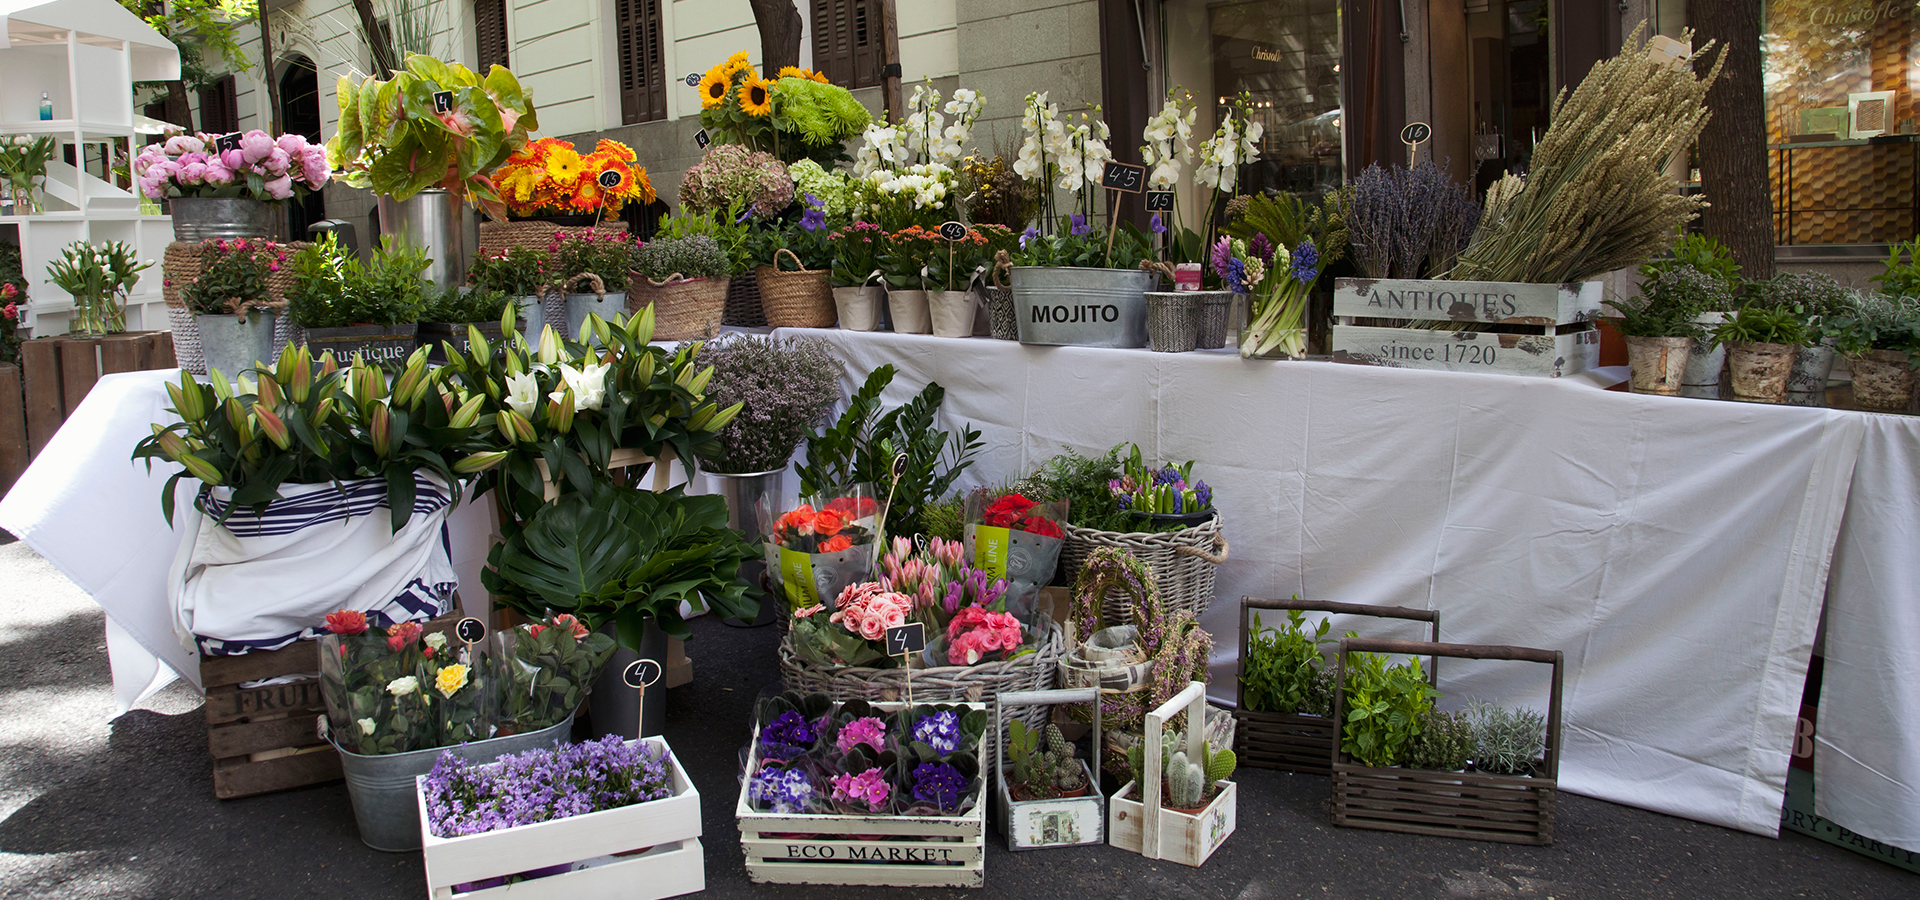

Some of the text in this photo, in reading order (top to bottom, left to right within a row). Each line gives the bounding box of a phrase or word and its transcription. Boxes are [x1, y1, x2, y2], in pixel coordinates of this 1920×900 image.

[439, 95, 447, 109] 4
[699, 133, 705, 144] 6
[1408, 126, 1423, 139] 16
[223, 136, 233, 152] 5
[1109, 166, 1139, 188] 4'5
[1151, 193, 1171, 208] 15
[946, 224, 962, 238] 4'5
[1367, 289, 1516, 316] ANTIQUES
[1031, 304, 1119, 323] MOJITO
[1381, 340, 1496, 366] since 1720
[987, 538, 998, 563] LINE
[792, 562, 806, 584] LINE
[461, 620, 474, 637] 5
[894, 629, 908, 650] 4
[634, 663, 647, 682] 4
[786, 845, 953, 862] ECO MARKET
